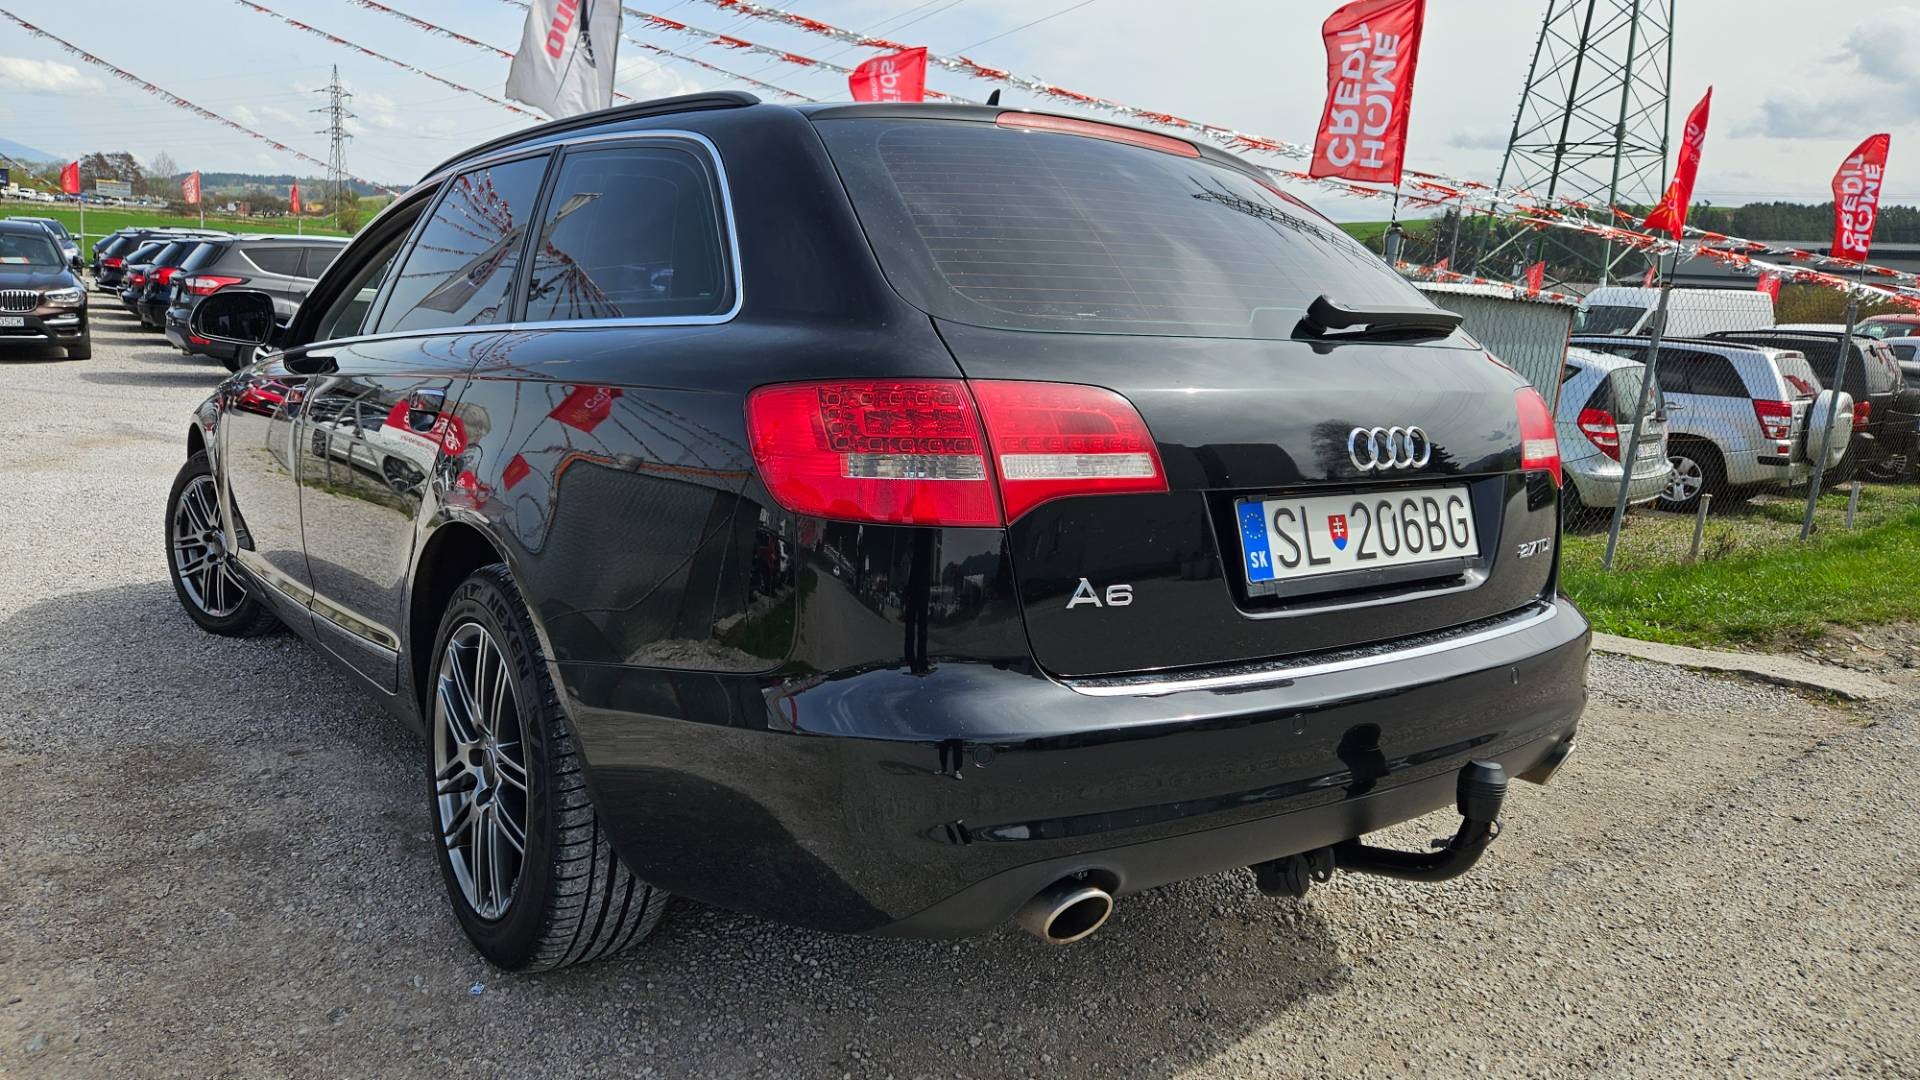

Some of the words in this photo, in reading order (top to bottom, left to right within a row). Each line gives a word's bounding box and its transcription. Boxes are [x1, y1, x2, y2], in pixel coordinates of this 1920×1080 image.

[1273, 506, 1331, 568] SL
[1350, 494, 1469, 561] 206BG
[1250, 551, 1269, 569] SK
[1065, 577, 1133, 609] A6
[486, 592, 530, 681] NEXEN
